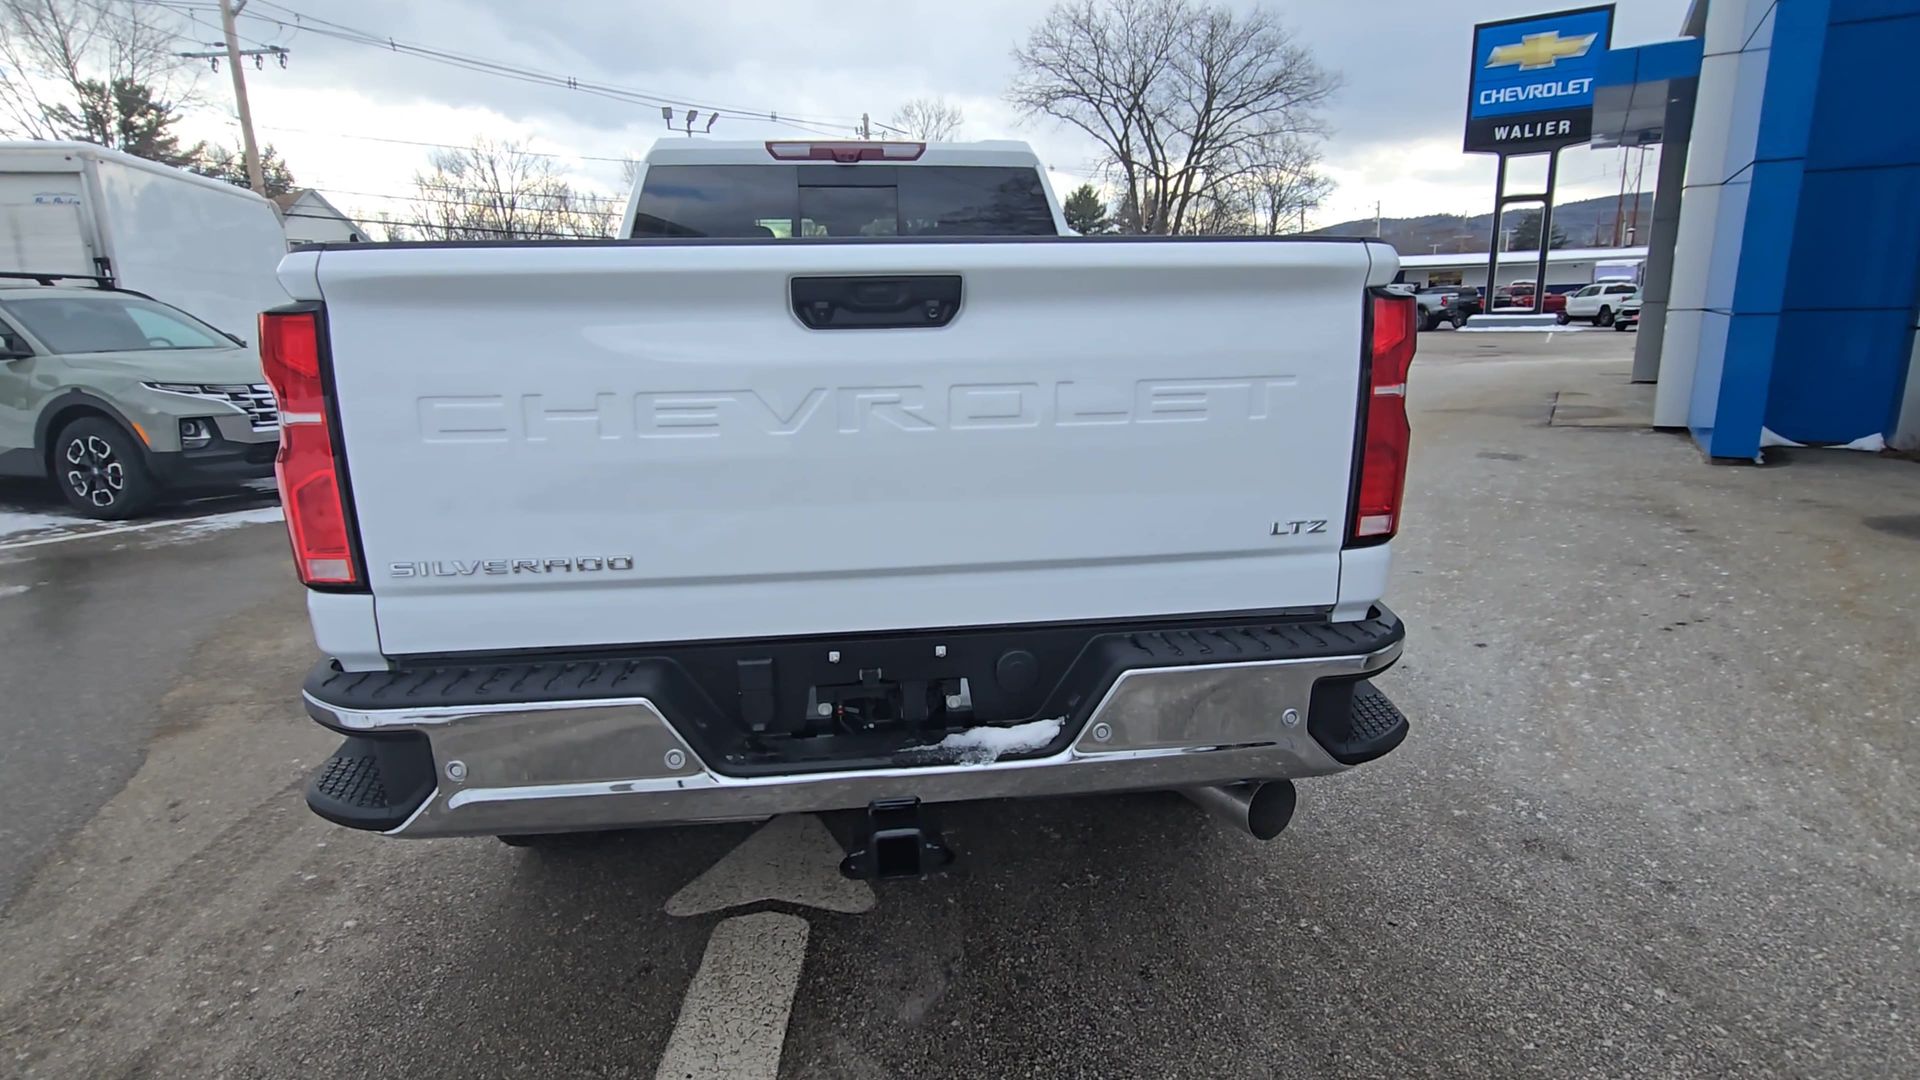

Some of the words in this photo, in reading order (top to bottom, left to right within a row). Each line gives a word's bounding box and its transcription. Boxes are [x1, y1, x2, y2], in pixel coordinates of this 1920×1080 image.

[1480, 77, 1593, 105] CHEVROLET
[1494, 120, 1571, 140] WALIER
[416, 374, 1297, 444] CHEVROLET
[1270, 520, 1328, 536] LTZ
[389, 555, 634, 578] SILVERADO
